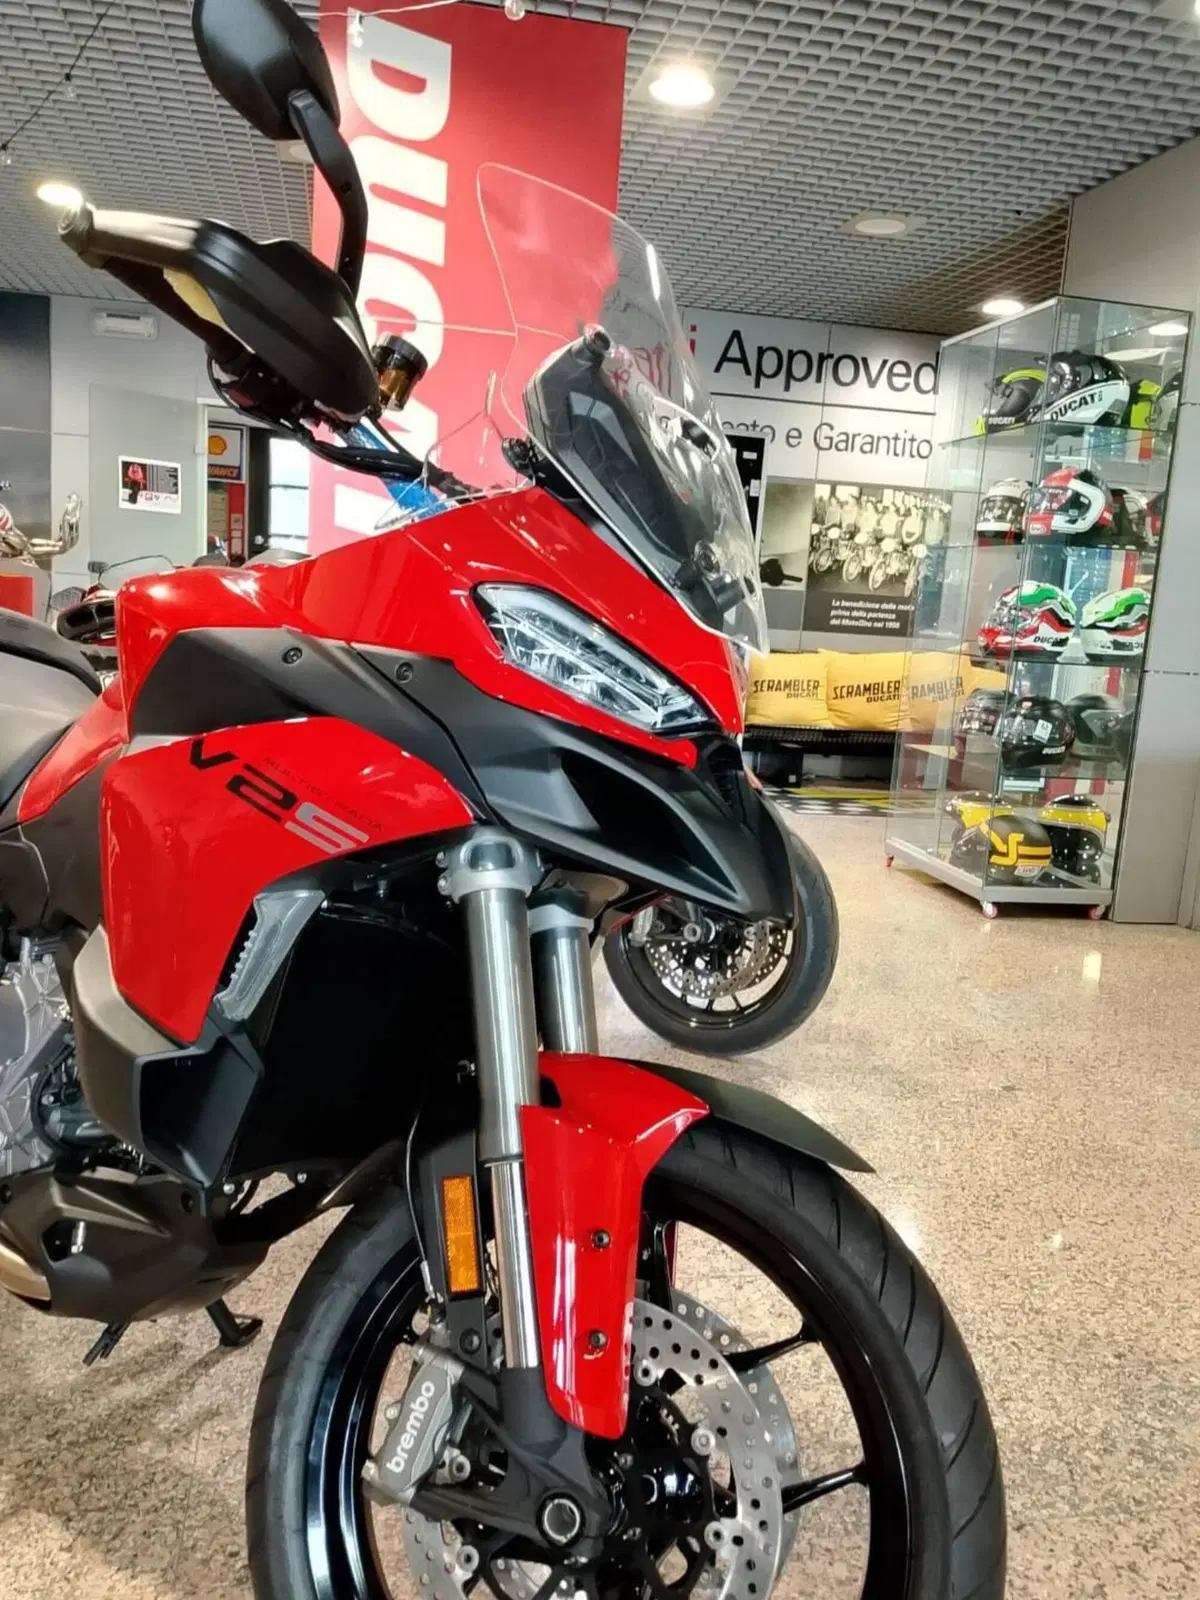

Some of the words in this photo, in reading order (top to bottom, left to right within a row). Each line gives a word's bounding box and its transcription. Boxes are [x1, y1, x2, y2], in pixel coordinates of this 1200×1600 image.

[713, 329, 939, 395] Approved
[1050, 390, 1104, 422] DUCATI
[785, 426, 803, 448] e
[813, 421, 934, 460] Garantito
[752, 679, 820, 694] SCRAMBLER
[786, 691, 819, 699] DUCATI
[832, 680, 901, 700] SCRAMBLER
[865, 694, 901, 704] DUCATI
[385, 1380, 435, 1473] brembo
